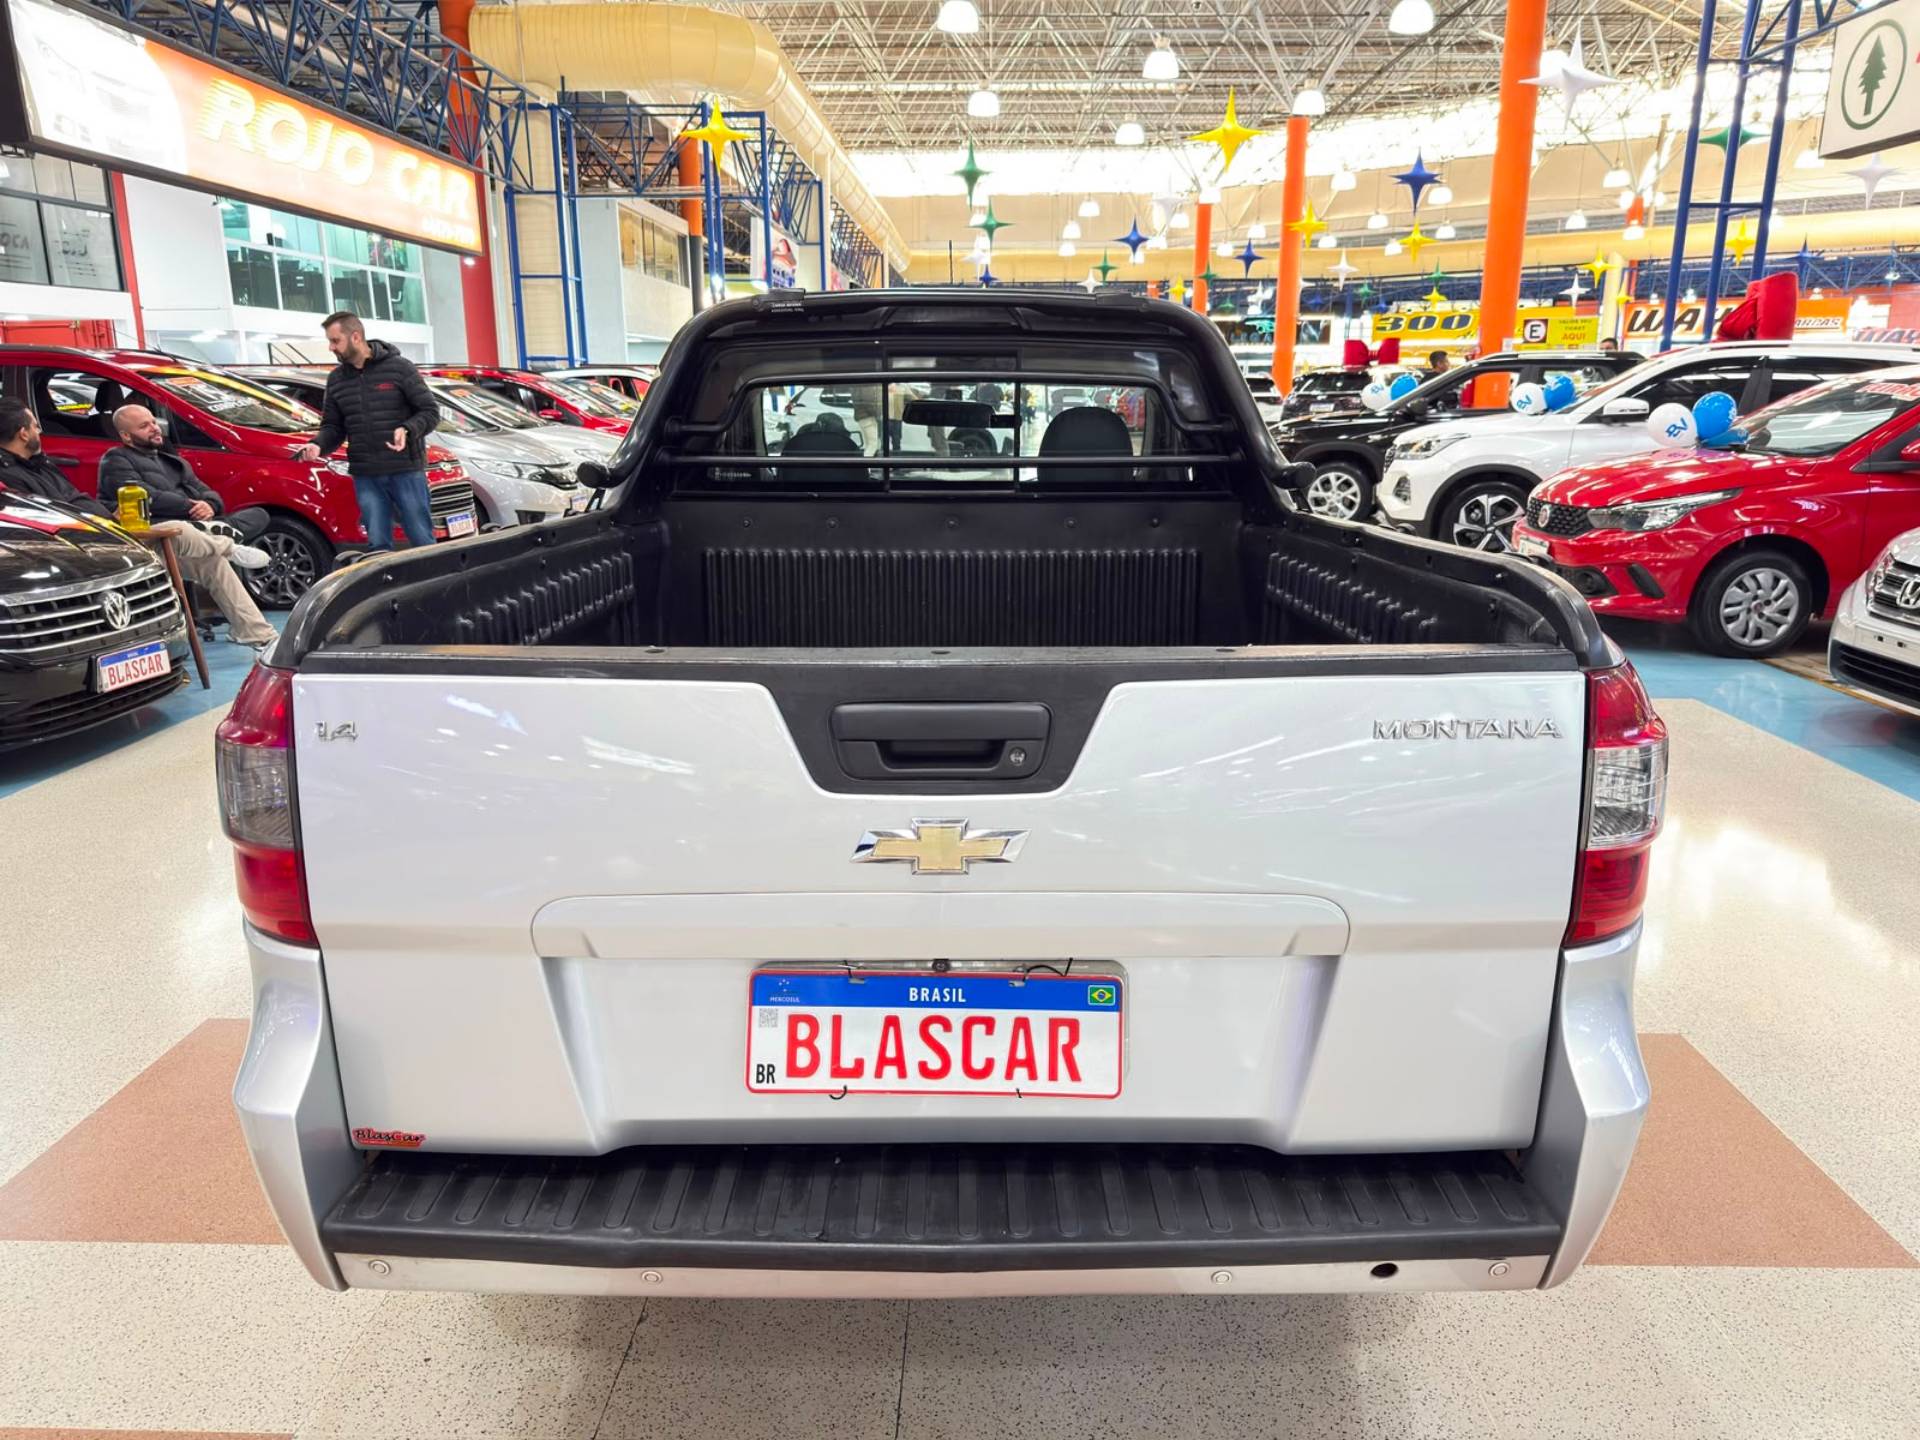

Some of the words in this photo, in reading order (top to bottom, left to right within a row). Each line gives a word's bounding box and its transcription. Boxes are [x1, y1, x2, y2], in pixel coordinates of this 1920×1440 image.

[199, 77, 375, 186] ROJO
[386, 150, 471, 221] CAR
[1375, 313, 1473, 332] 300
[1528, 323, 1542, 339] E
[1561, 332, 1586, 341] AQUI
[108, 653, 164, 686] BLASCAR
[1373, 718, 1563, 740] MONTANA
[908, 987, 967, 1003] BRASIL
[786, 1014, 1082, 1082] BLASCAR
[755, 1063, 776, 1085] BR
